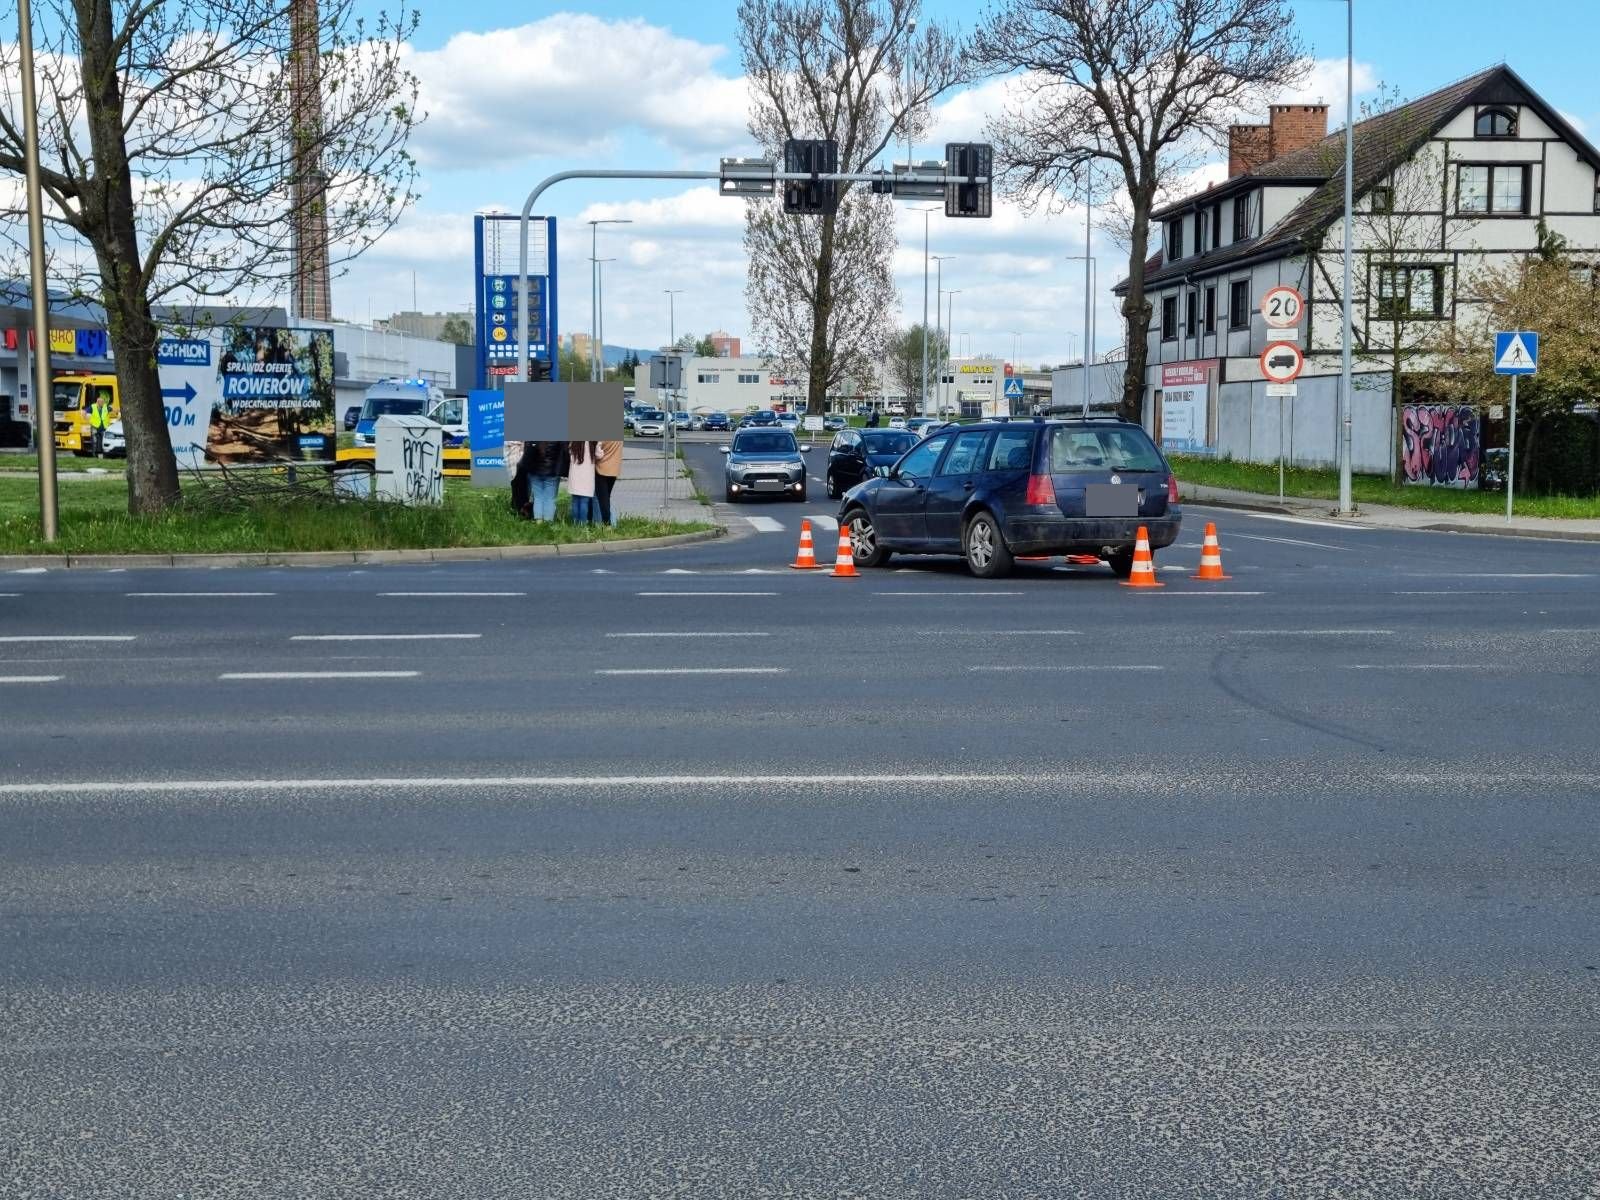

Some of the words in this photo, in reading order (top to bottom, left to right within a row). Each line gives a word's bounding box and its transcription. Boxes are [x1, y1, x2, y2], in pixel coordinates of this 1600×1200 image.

[1269, 297, 1297, 317] 20
[50, 329, 74, 345] URO
[158, 343, 207, 358] CATHLON
[226, 361, 265, 373] SPRAWDŹ
[265, 362, 293, 375] OFERTĘ
[228, 375, 305, 395] ROWERÓW
[232, 400, 240, 408] W
[240, 400, 278, 408] DECATHLON
[279, 400, 302, 408] JELENIA
[302, 399, 321, 408] GÓRA
[163, 406, 182, 426] 00
[184, 413, 196, 426] M
